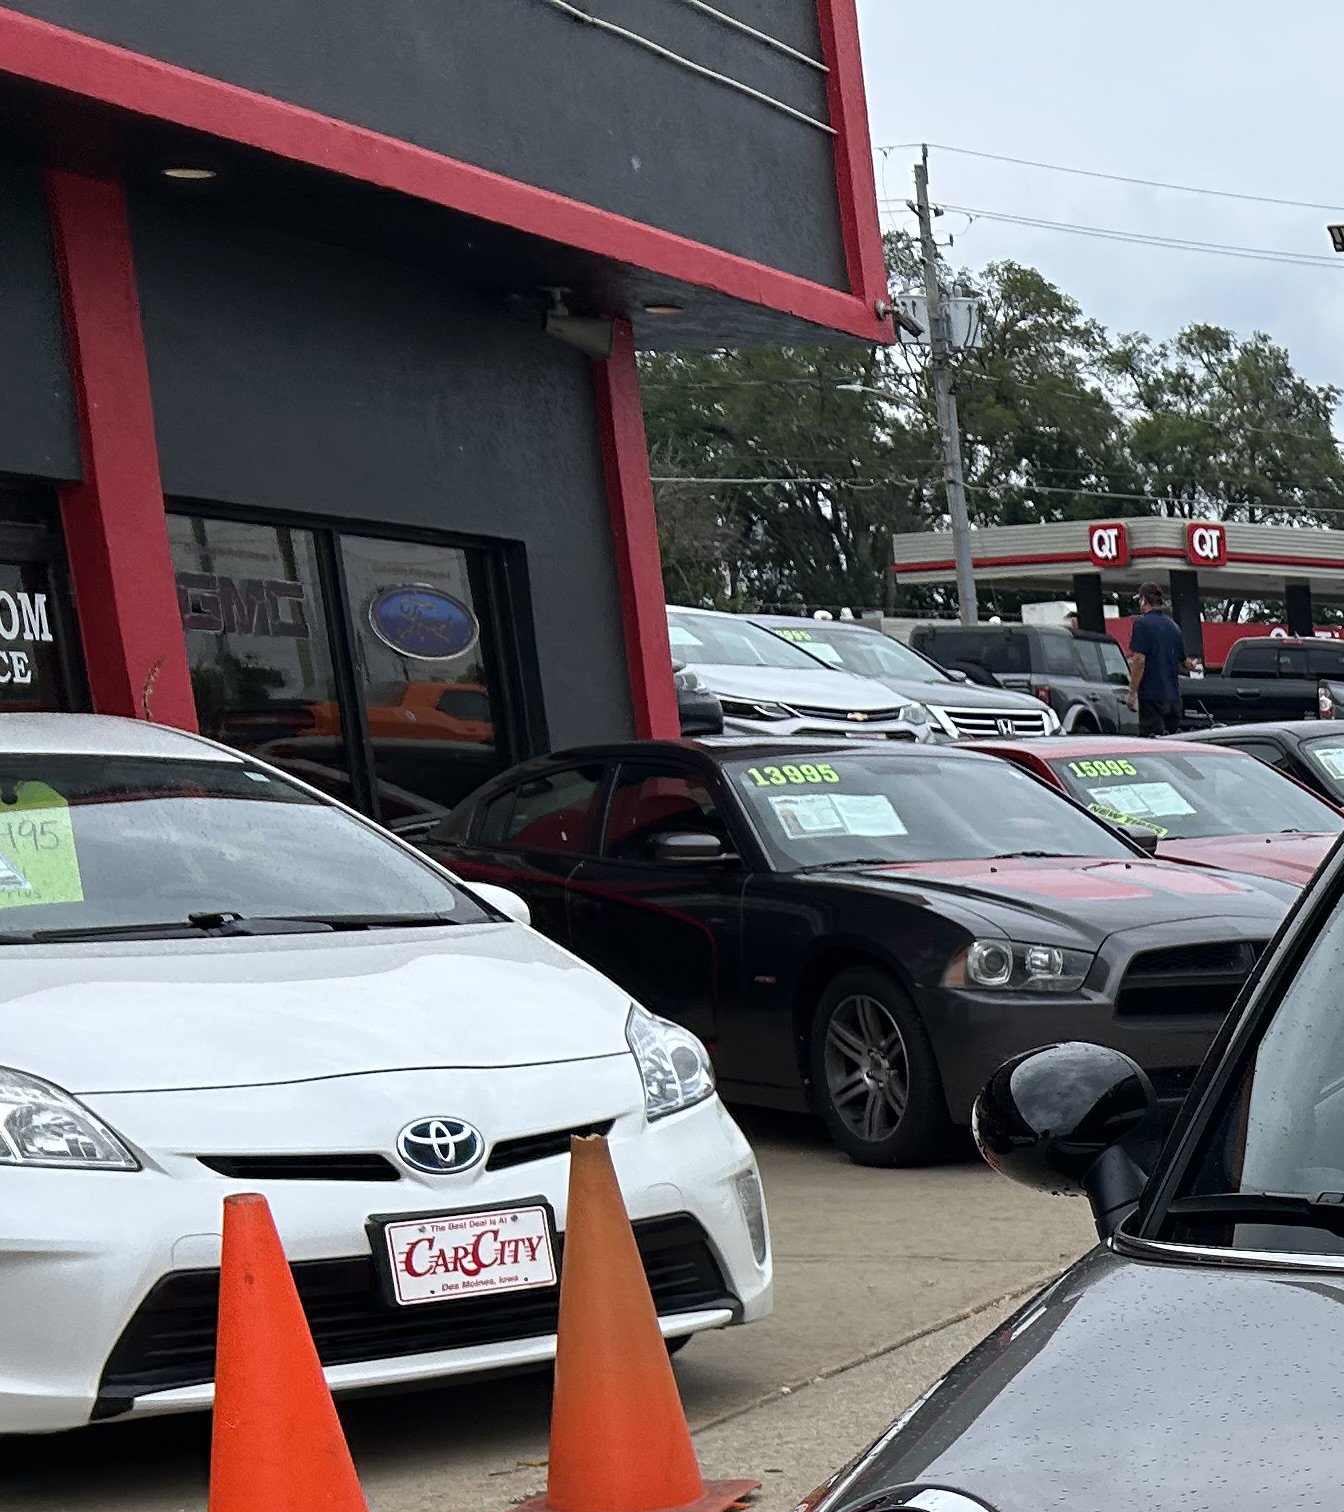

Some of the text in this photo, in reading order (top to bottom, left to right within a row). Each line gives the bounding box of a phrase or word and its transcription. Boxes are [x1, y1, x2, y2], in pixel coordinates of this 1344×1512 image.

[1092, 528, 1119, 560] QT
[1193, 528, 1221, 560] QT
[748, 763, 840, 787] 13995
